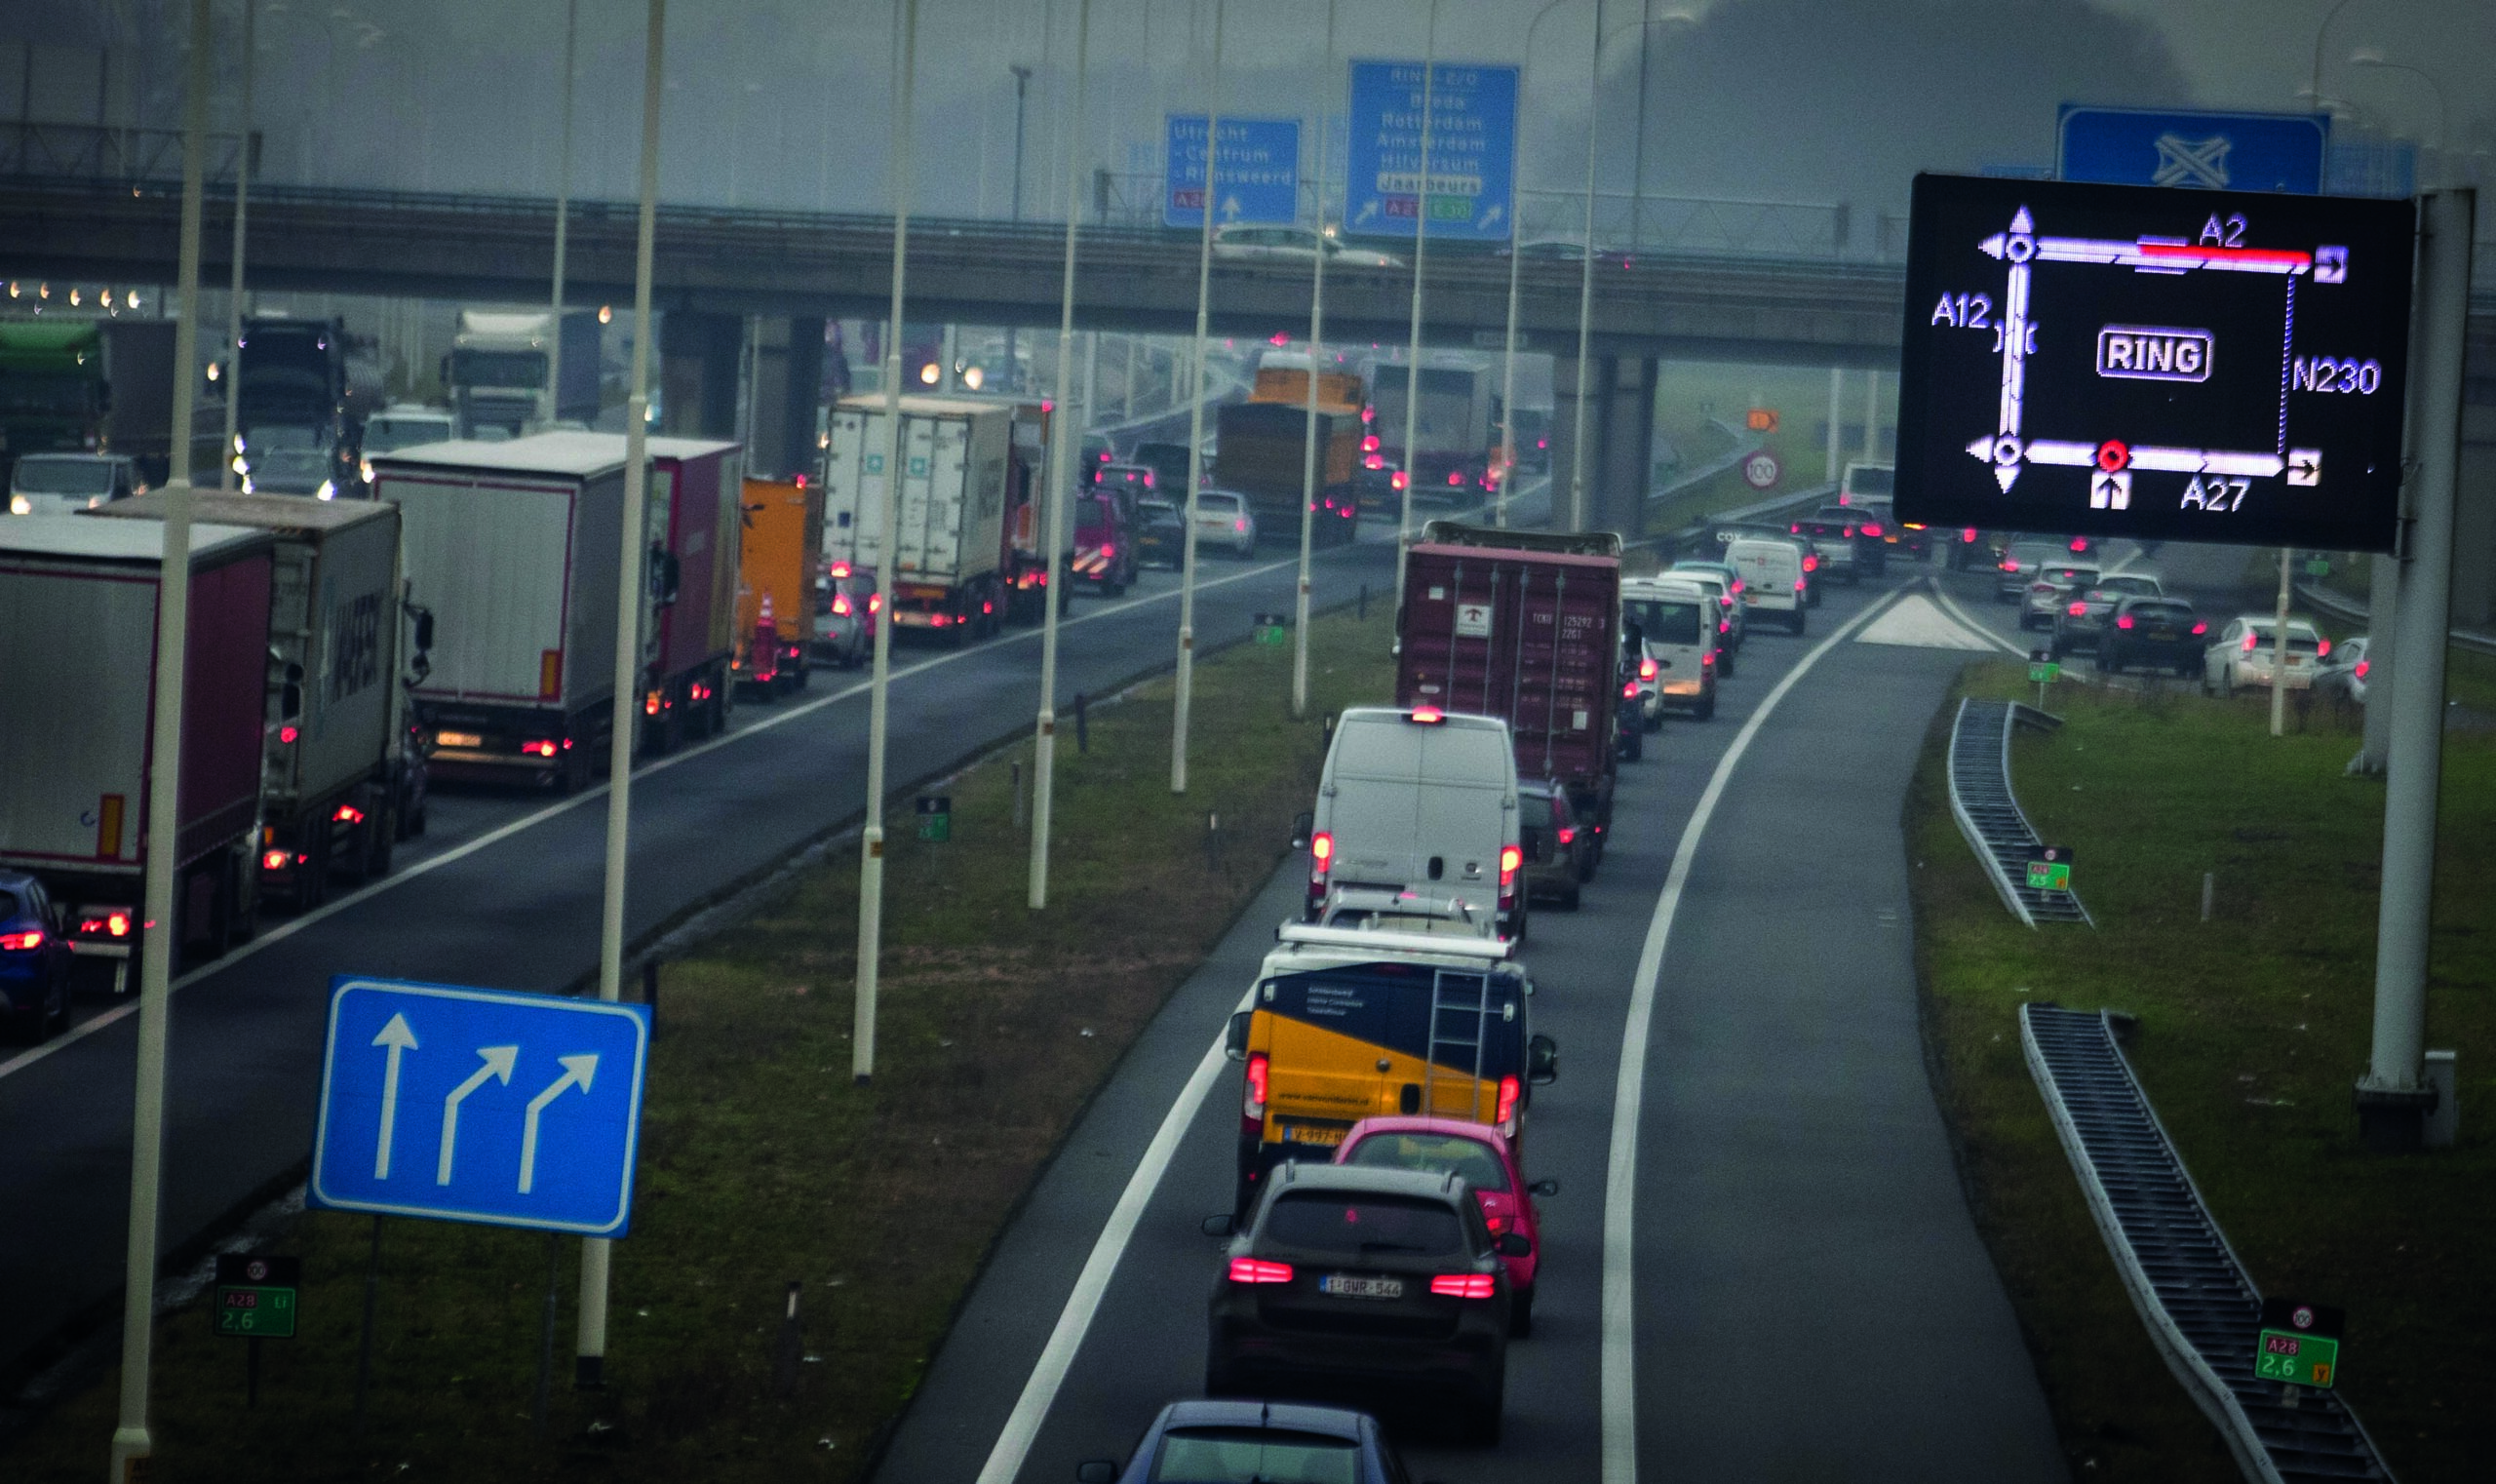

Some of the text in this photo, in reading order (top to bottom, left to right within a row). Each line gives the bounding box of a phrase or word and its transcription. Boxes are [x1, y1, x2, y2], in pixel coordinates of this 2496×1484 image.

[1391, 69, 1431, 82] RIN
[1411, 95, 1464, 109] Beda
[1175, 125, 1247, 141] Utrcht
[2200, 212, 2248, 248] A2
[1931, 291, 1992, 328] A12
[2107, 336, 2203, 373] RING
[2292, 355, 2382, 395] N230
[1750, 463, 1774, 480] 100
[2180, 474, 2252, 512] A27
[226, 1294, 255, 1308] A28
[221, 1311, 254, 1331] 2,6
[2268, 1339, 2298, 1355] A28
[2262, 1355, 2295, 1377] 2,6
